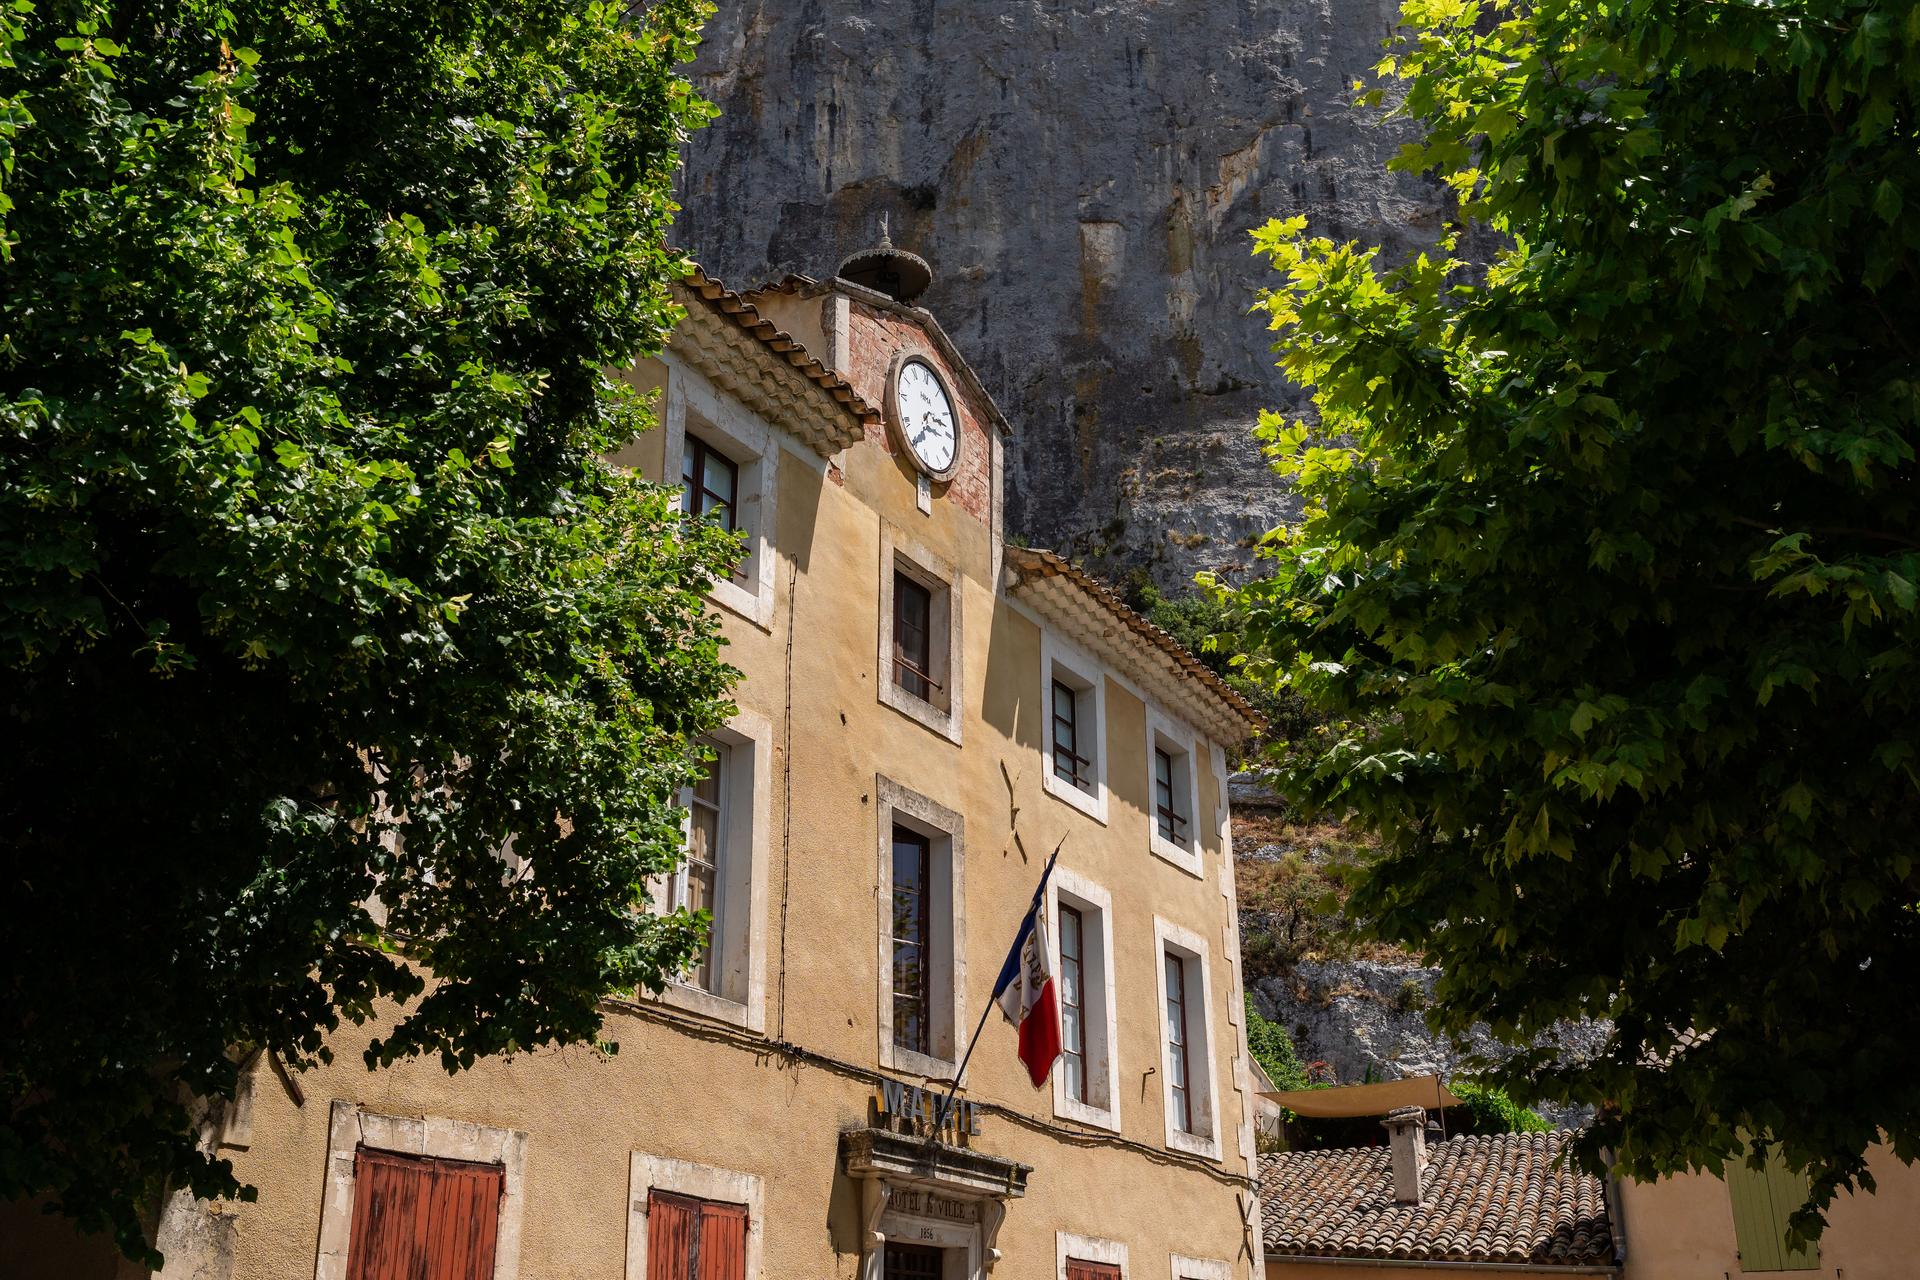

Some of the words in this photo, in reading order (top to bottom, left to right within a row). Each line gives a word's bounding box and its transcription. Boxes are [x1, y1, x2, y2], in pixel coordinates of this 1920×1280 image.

[880, 1080, 981, 1136] MAIRIE
[938, 1200, 965, 1219] VILLE
[920, 1227, 934, 1240] 1856
